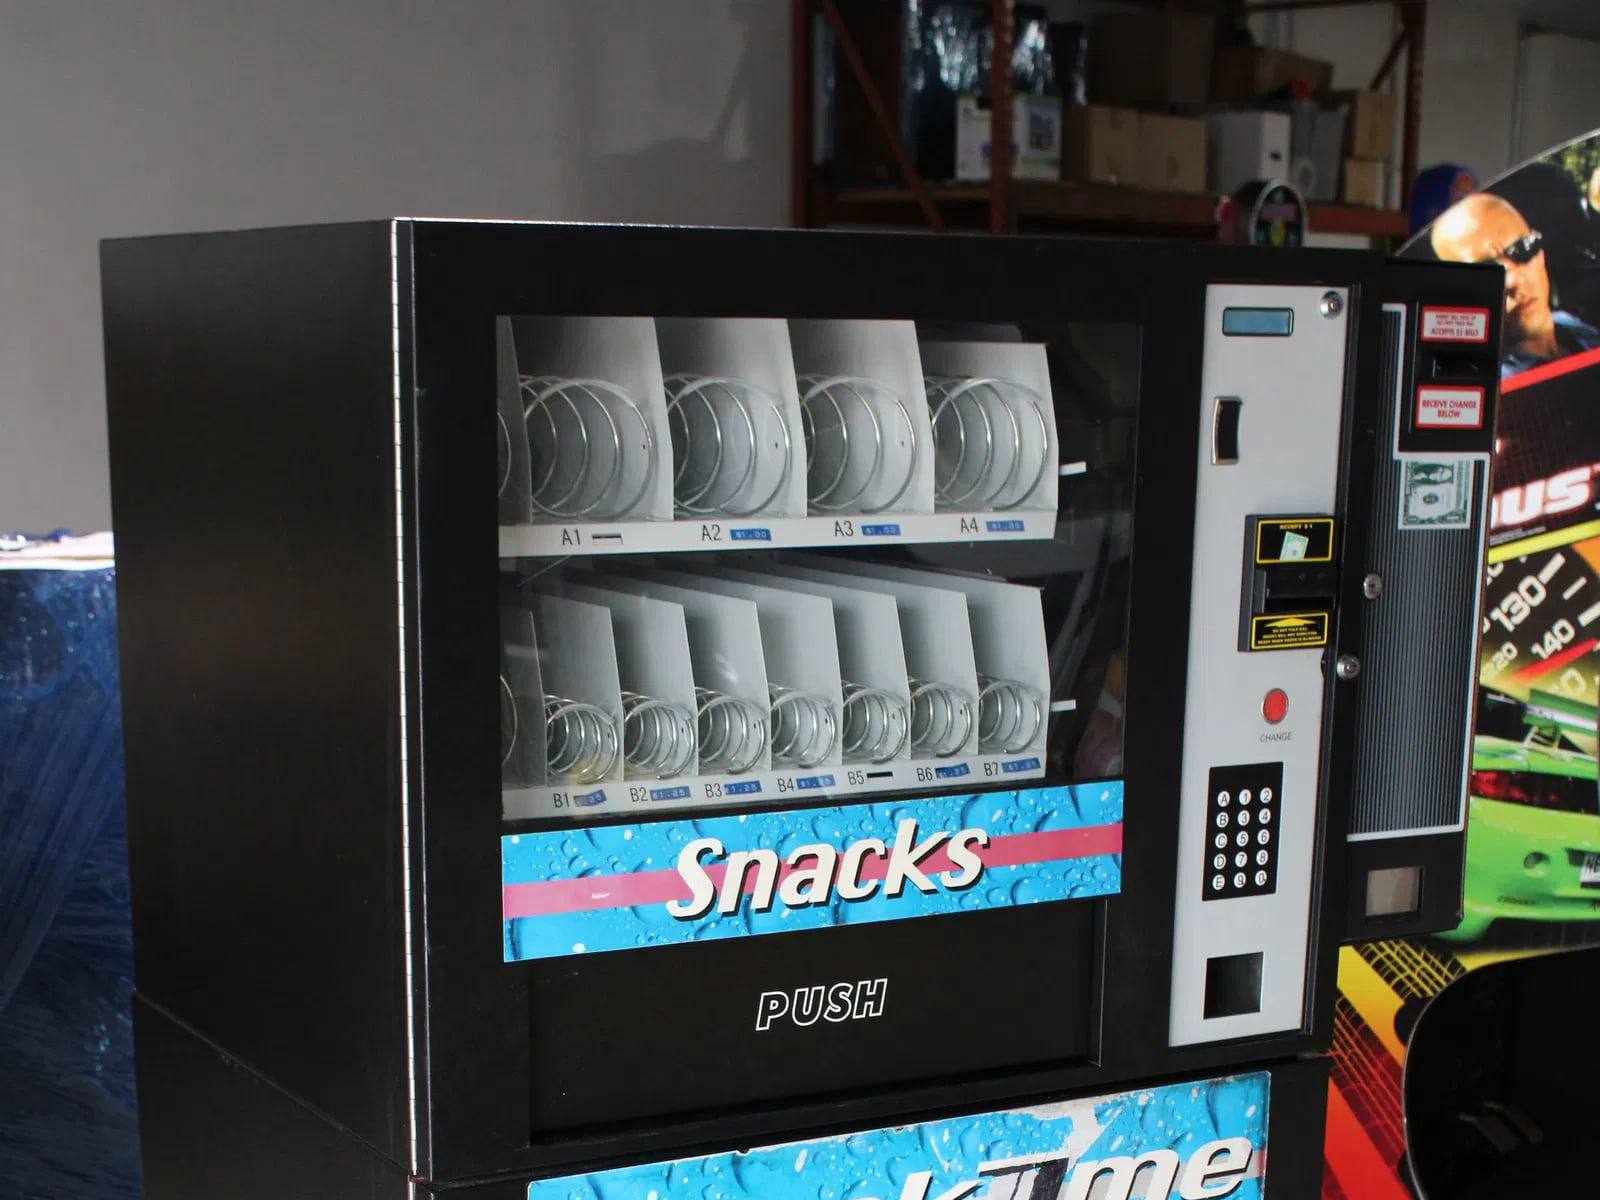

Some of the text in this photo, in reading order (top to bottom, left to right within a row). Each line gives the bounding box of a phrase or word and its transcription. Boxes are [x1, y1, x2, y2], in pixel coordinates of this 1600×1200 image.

[1422, 400, 1477, 408] RECEIVE CHANGE
[701, 523, 723, 542] A2
[834, 520, 855, 537] A3
[960, 517, 979, 533] A4
[561, 528, 581, 546] A1
[1490, 575, 1547, 632] 130
[1531, 618, 1575, 659] 140
[1260, 732, 1292, 742] CHANGE
[916, 767, 933, 782] B6
[983, 762, 999, 777] B7
[847, 770, 865, 785] B5
[705, 783, 723, 798] B3
[777, 778, 795, 793] B4
[553, 793, 571, 808] B1
[630, 787, 649, 802] B2
[666, 818, 988, 922] Snacks
[755, 978, 888, 1032] PUSH
